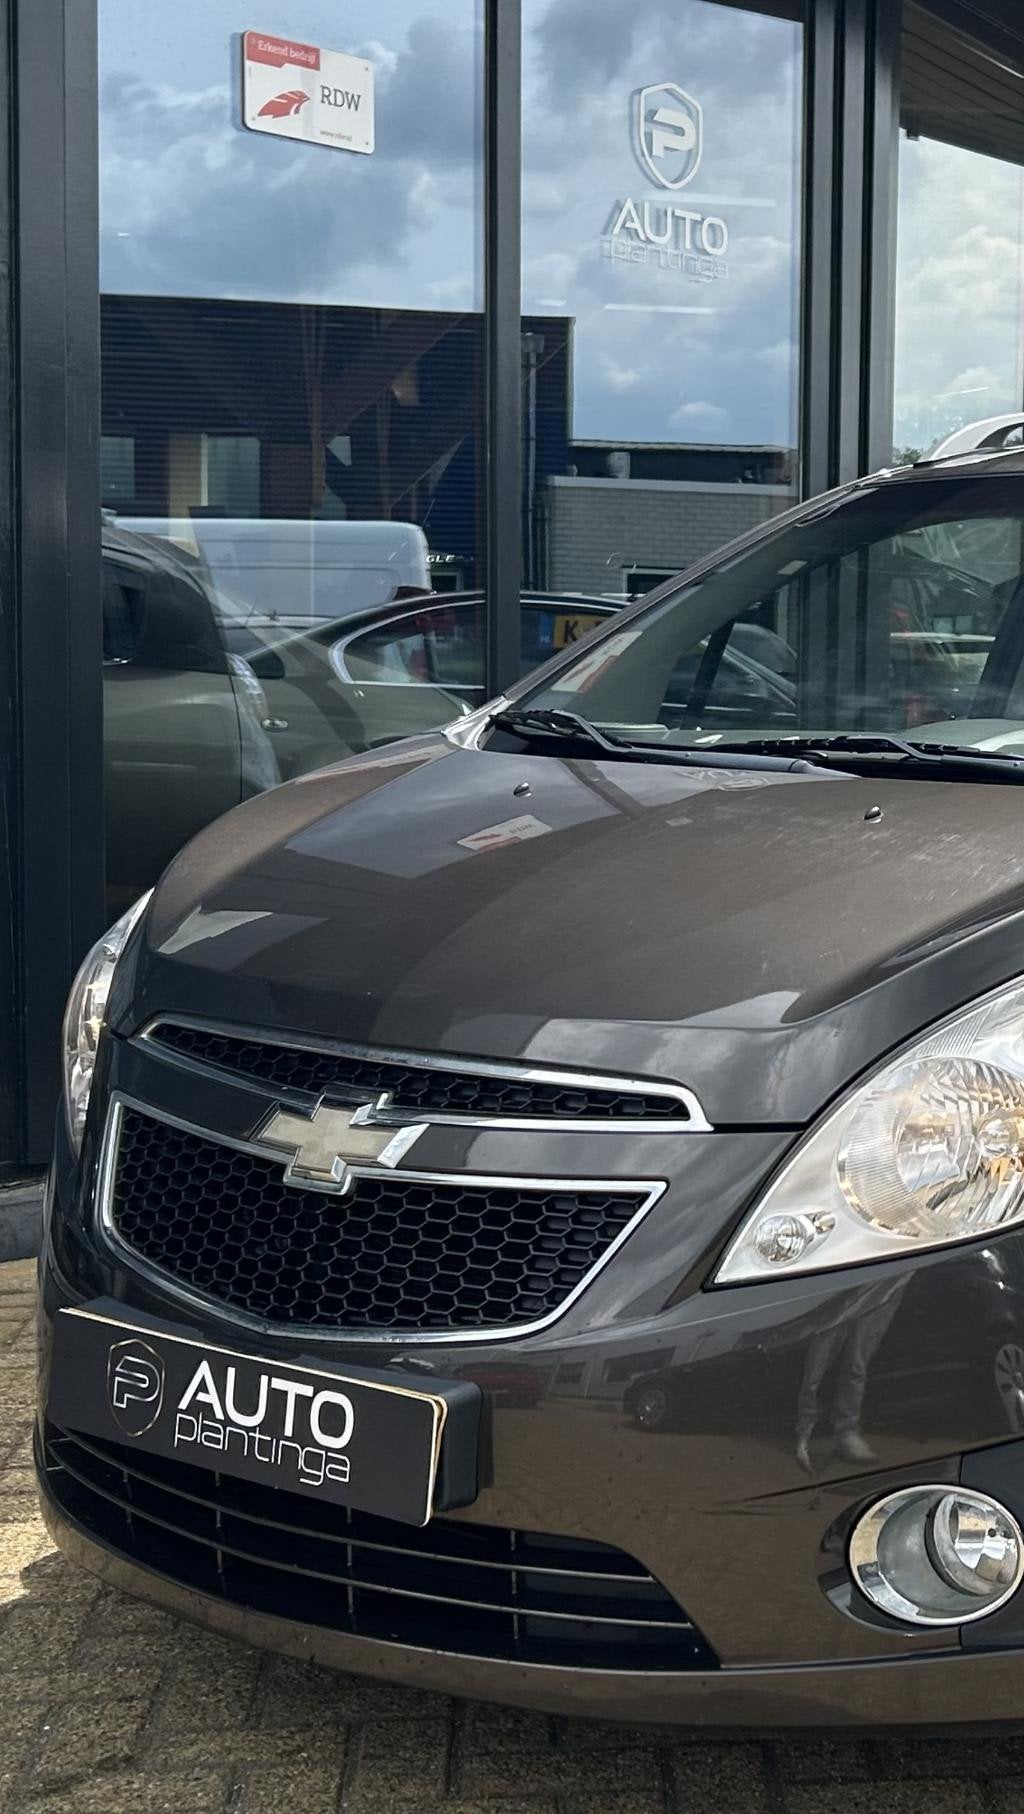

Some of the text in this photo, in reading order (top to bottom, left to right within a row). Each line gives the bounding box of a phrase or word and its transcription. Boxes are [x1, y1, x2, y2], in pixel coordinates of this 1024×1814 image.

[320, 85, 361, 112] RDW
[612, 198, 729, 256] AUTO
[178, 1360, 355, 1449] AUTO
[173, 1412, 351, 1486] plantinga
